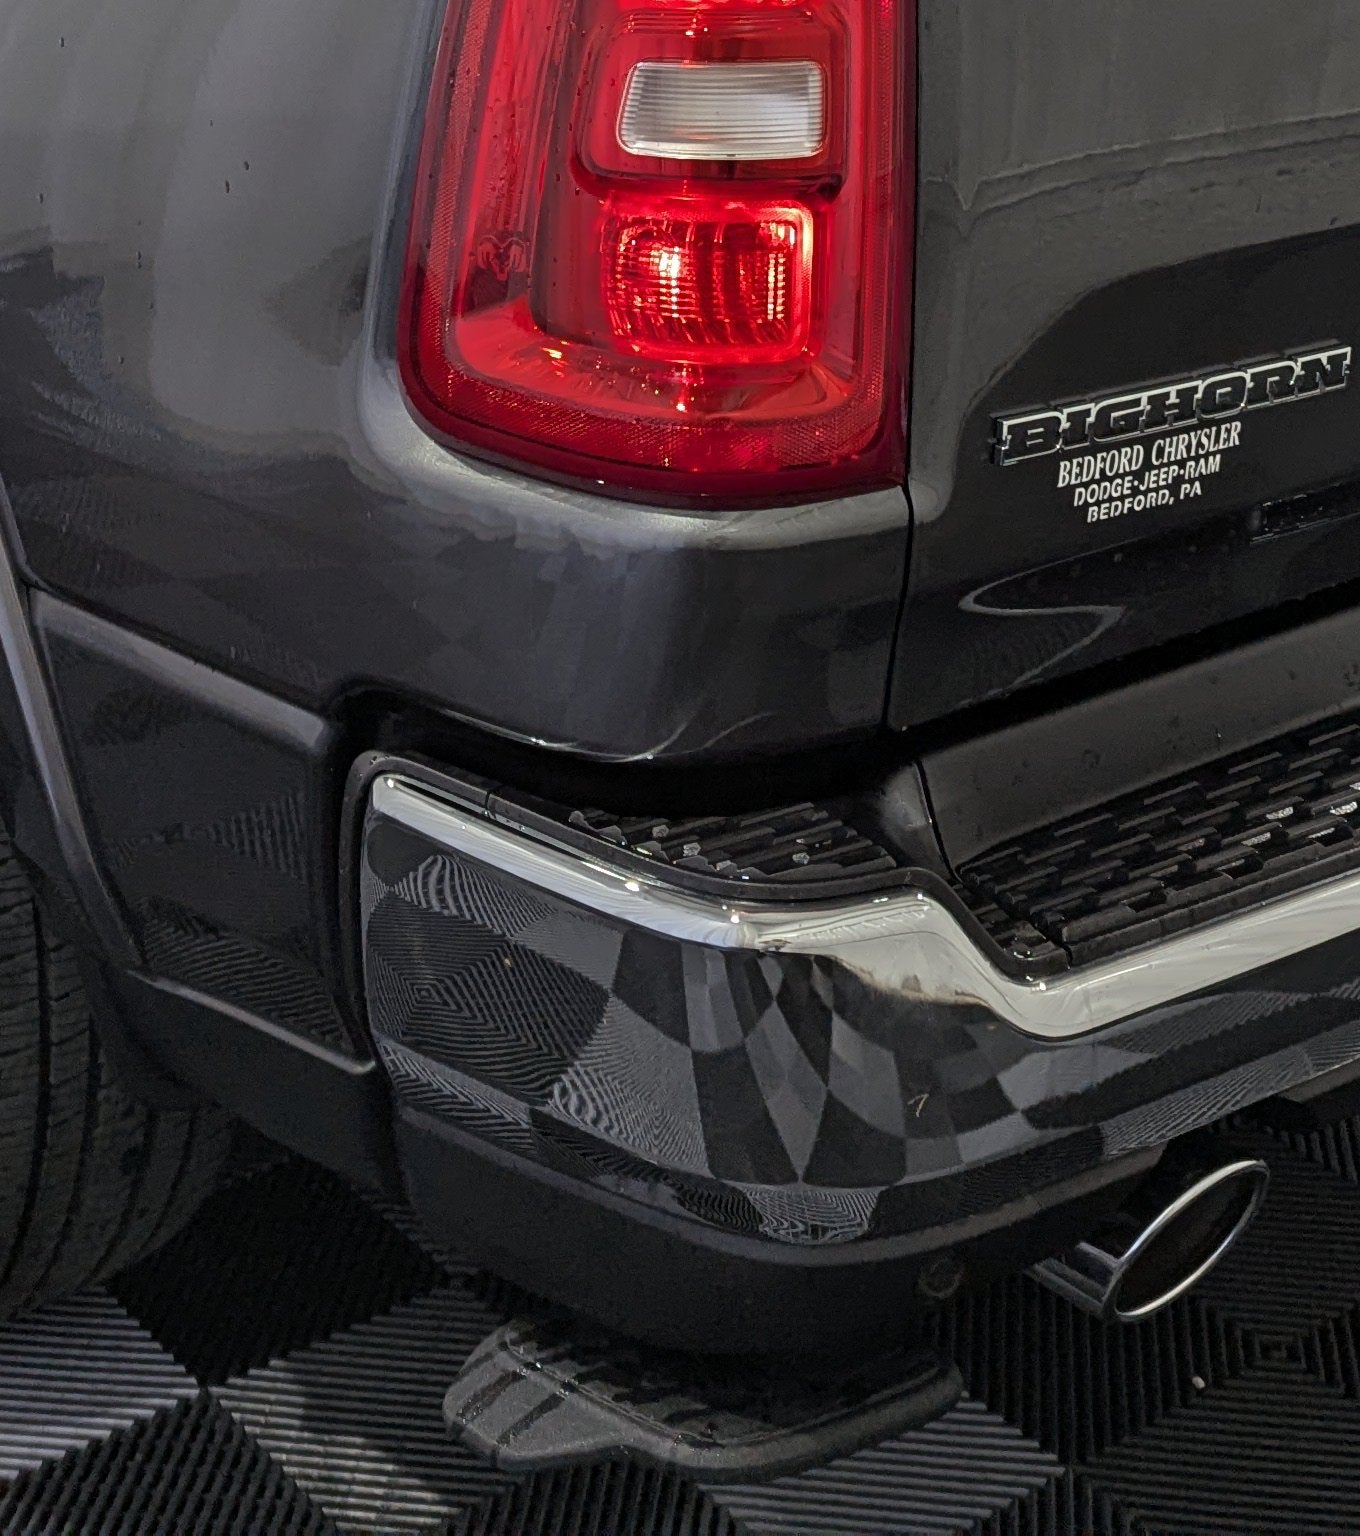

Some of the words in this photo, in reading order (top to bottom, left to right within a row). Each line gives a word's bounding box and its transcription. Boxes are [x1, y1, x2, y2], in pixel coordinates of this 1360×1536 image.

[1057, 445, 1144, 489] BEDFORD
[1151, 421, 1241, 465] CHRYSLER
[1087, 490, 1175, 523] BEDFORD,
[1180, 482, 1203, 499] PA
